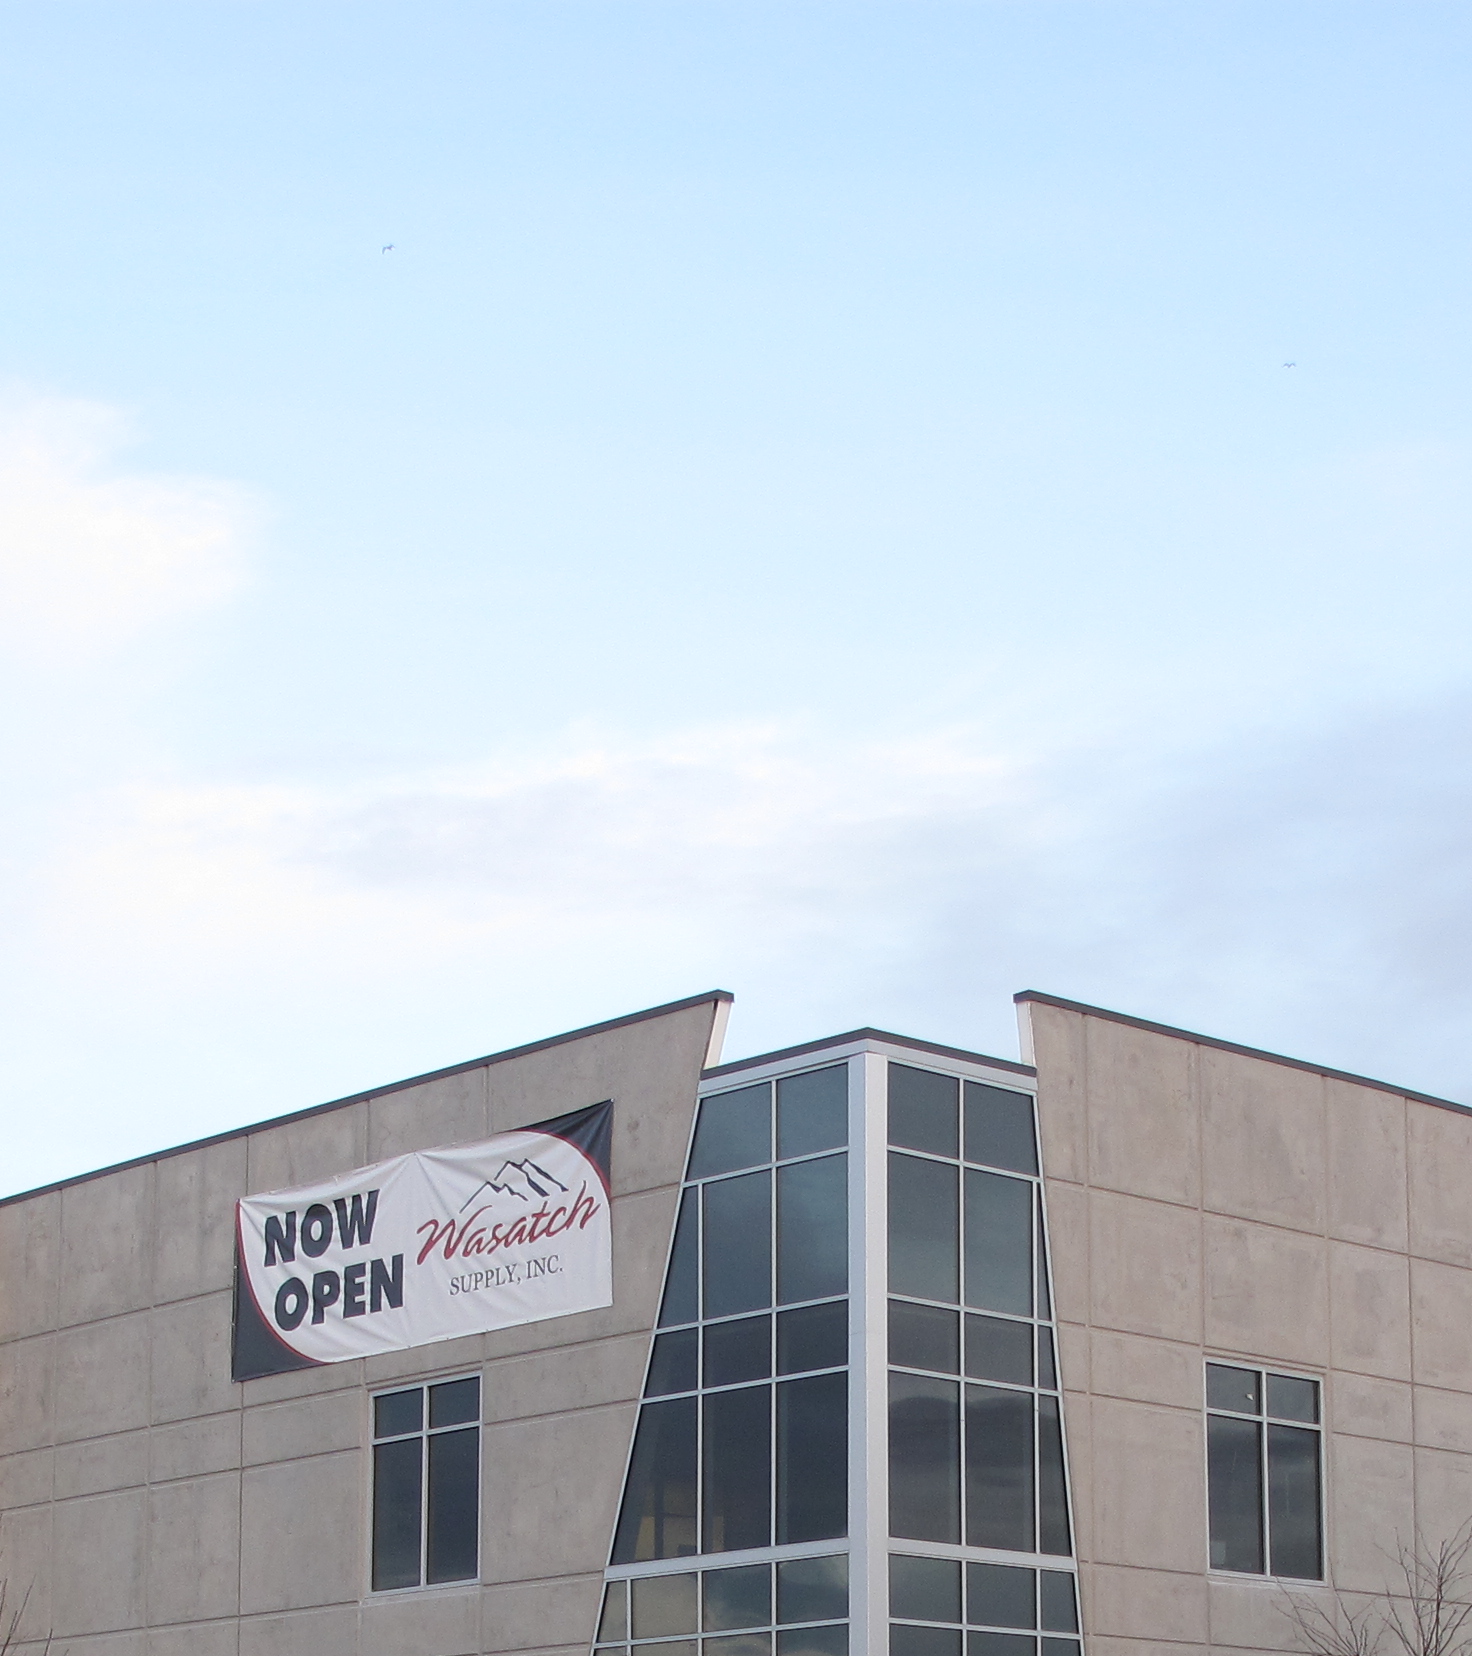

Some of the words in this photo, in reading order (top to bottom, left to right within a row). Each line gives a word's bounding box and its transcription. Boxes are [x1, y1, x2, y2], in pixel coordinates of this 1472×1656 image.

[263, 1189, 380, 1268] NOW
[416, 1180, 601, 1265] Wasatch
[274, 1253, 404, 1331] OPEN
[449, 1262, 521, 1297] SUPPLY,
[526, 1254, 564, 1280] INC.
